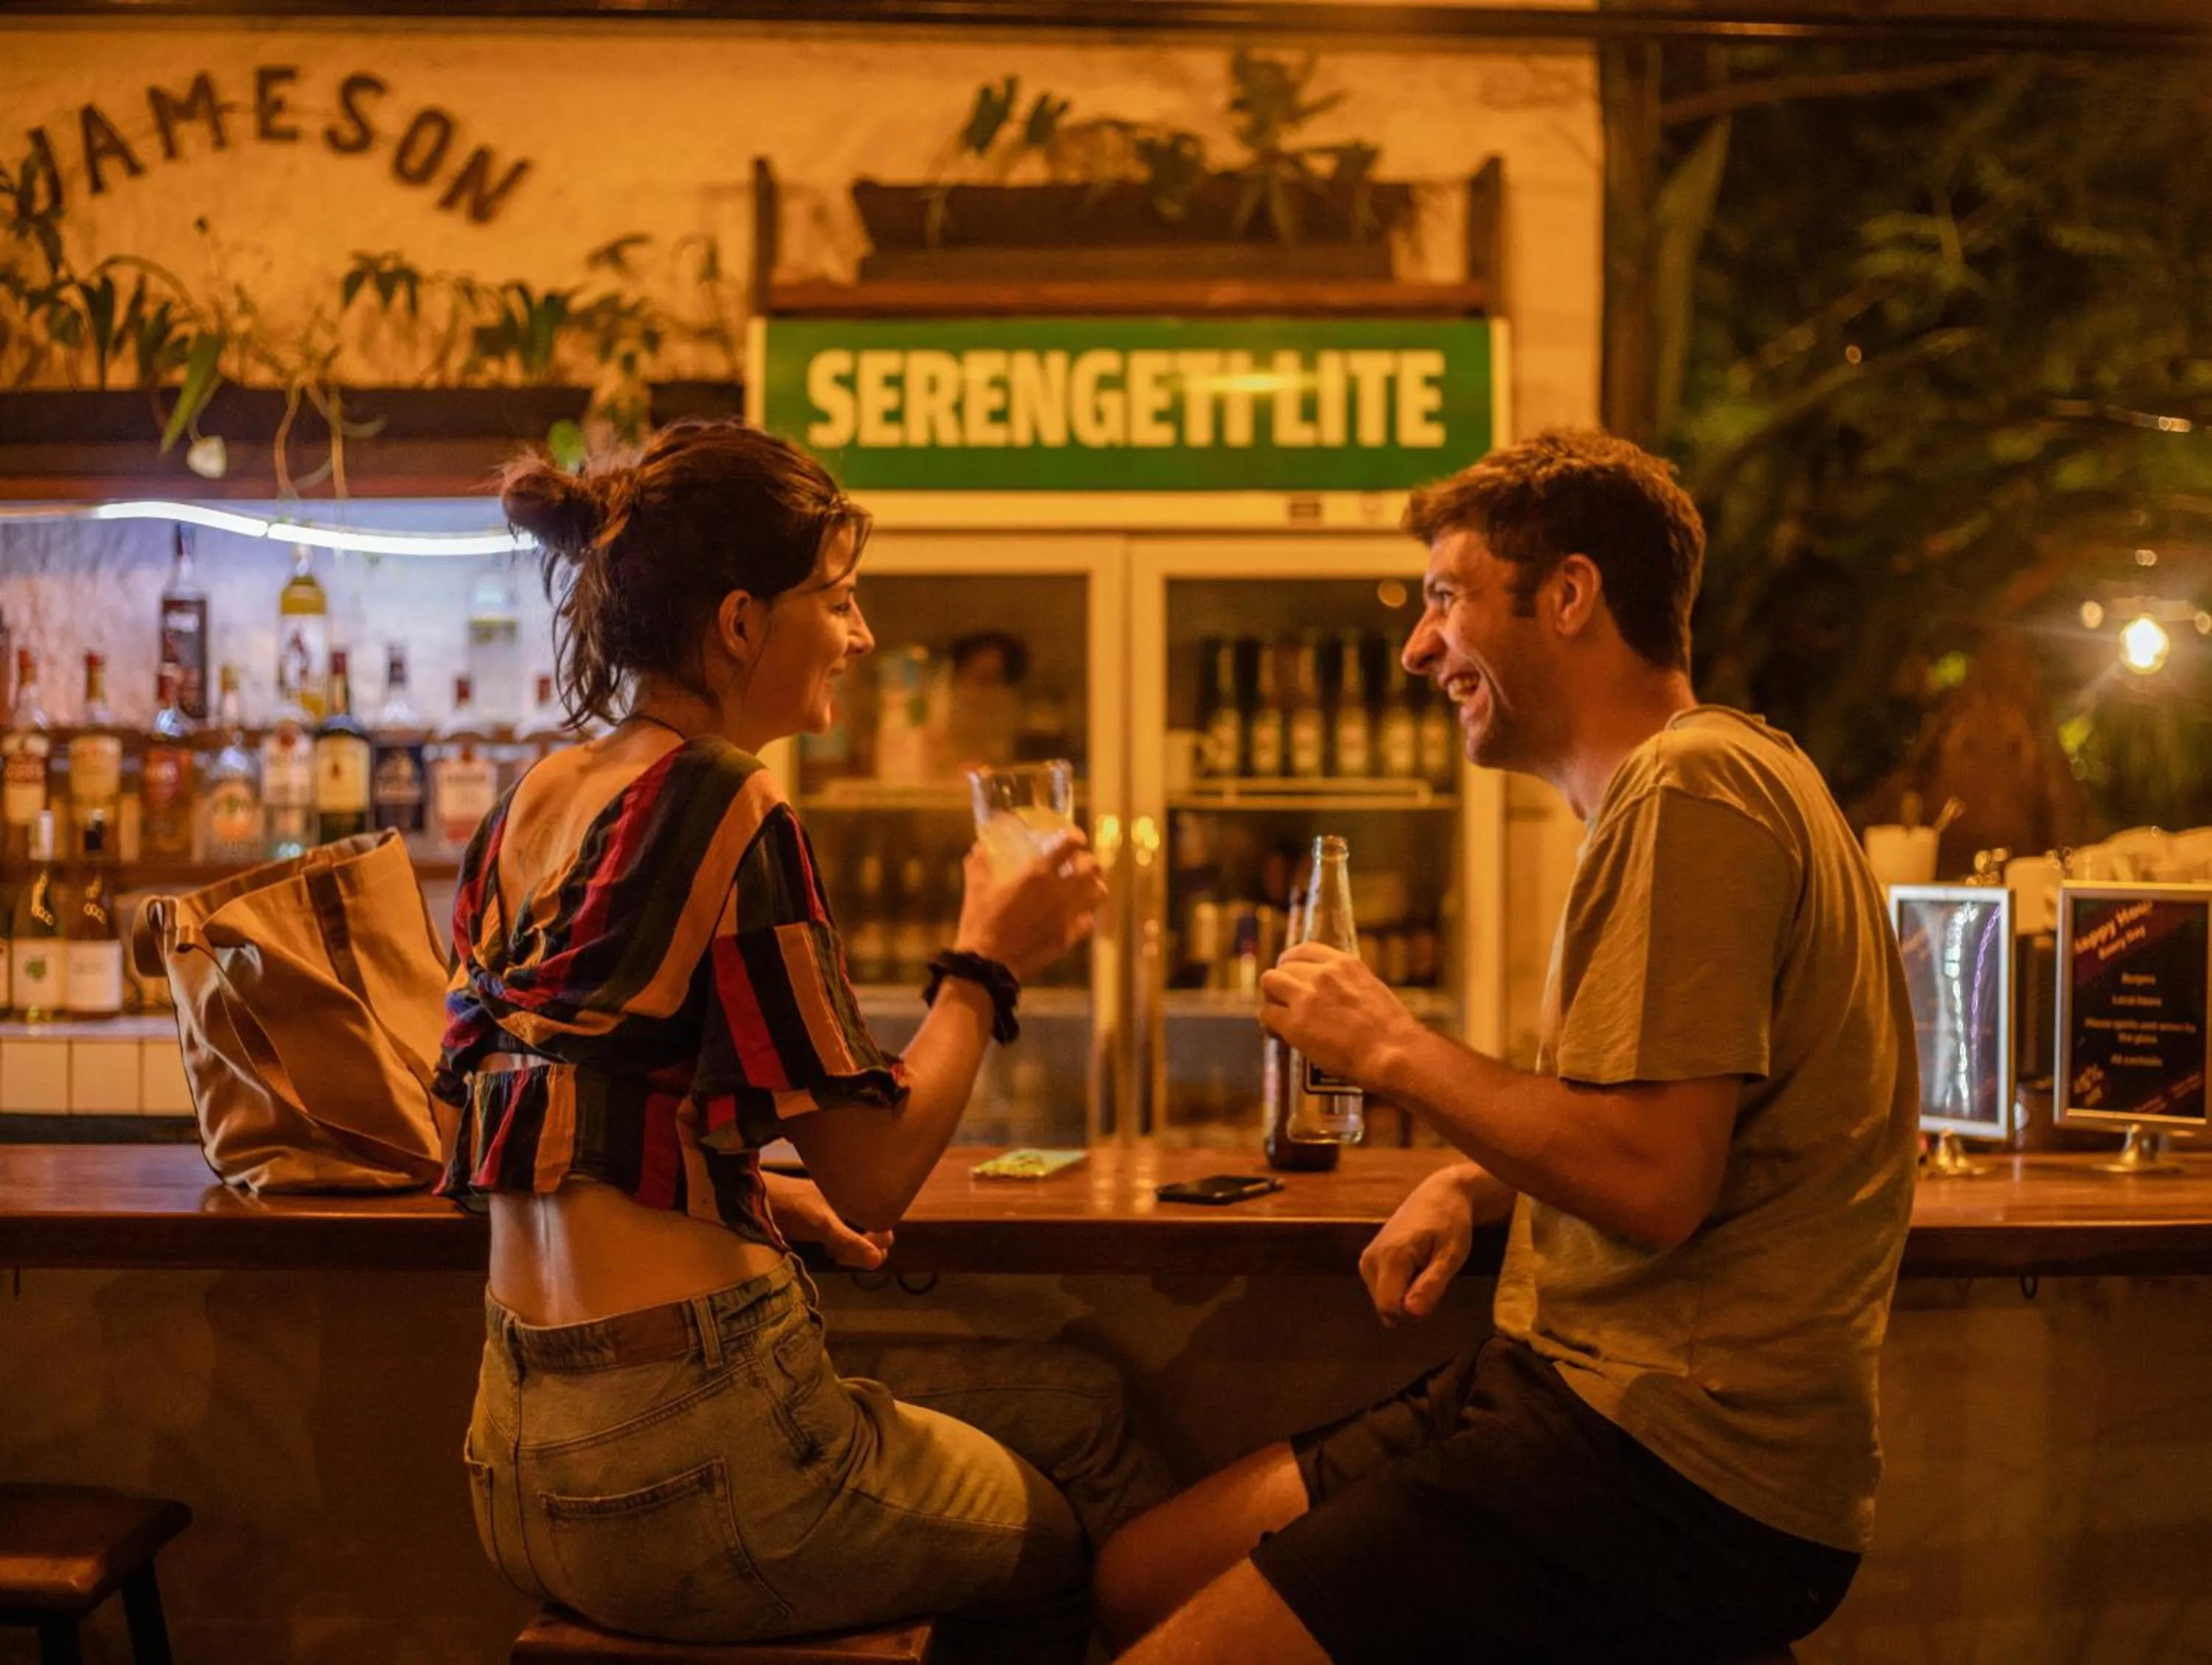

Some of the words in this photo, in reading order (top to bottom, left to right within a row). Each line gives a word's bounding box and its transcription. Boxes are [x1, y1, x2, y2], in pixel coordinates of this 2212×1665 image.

[18, 65, 532, 223] JAMESON
[807, 349, 1253, 448] SERENGETI
[1272, 349, 1445, 448] LITE
